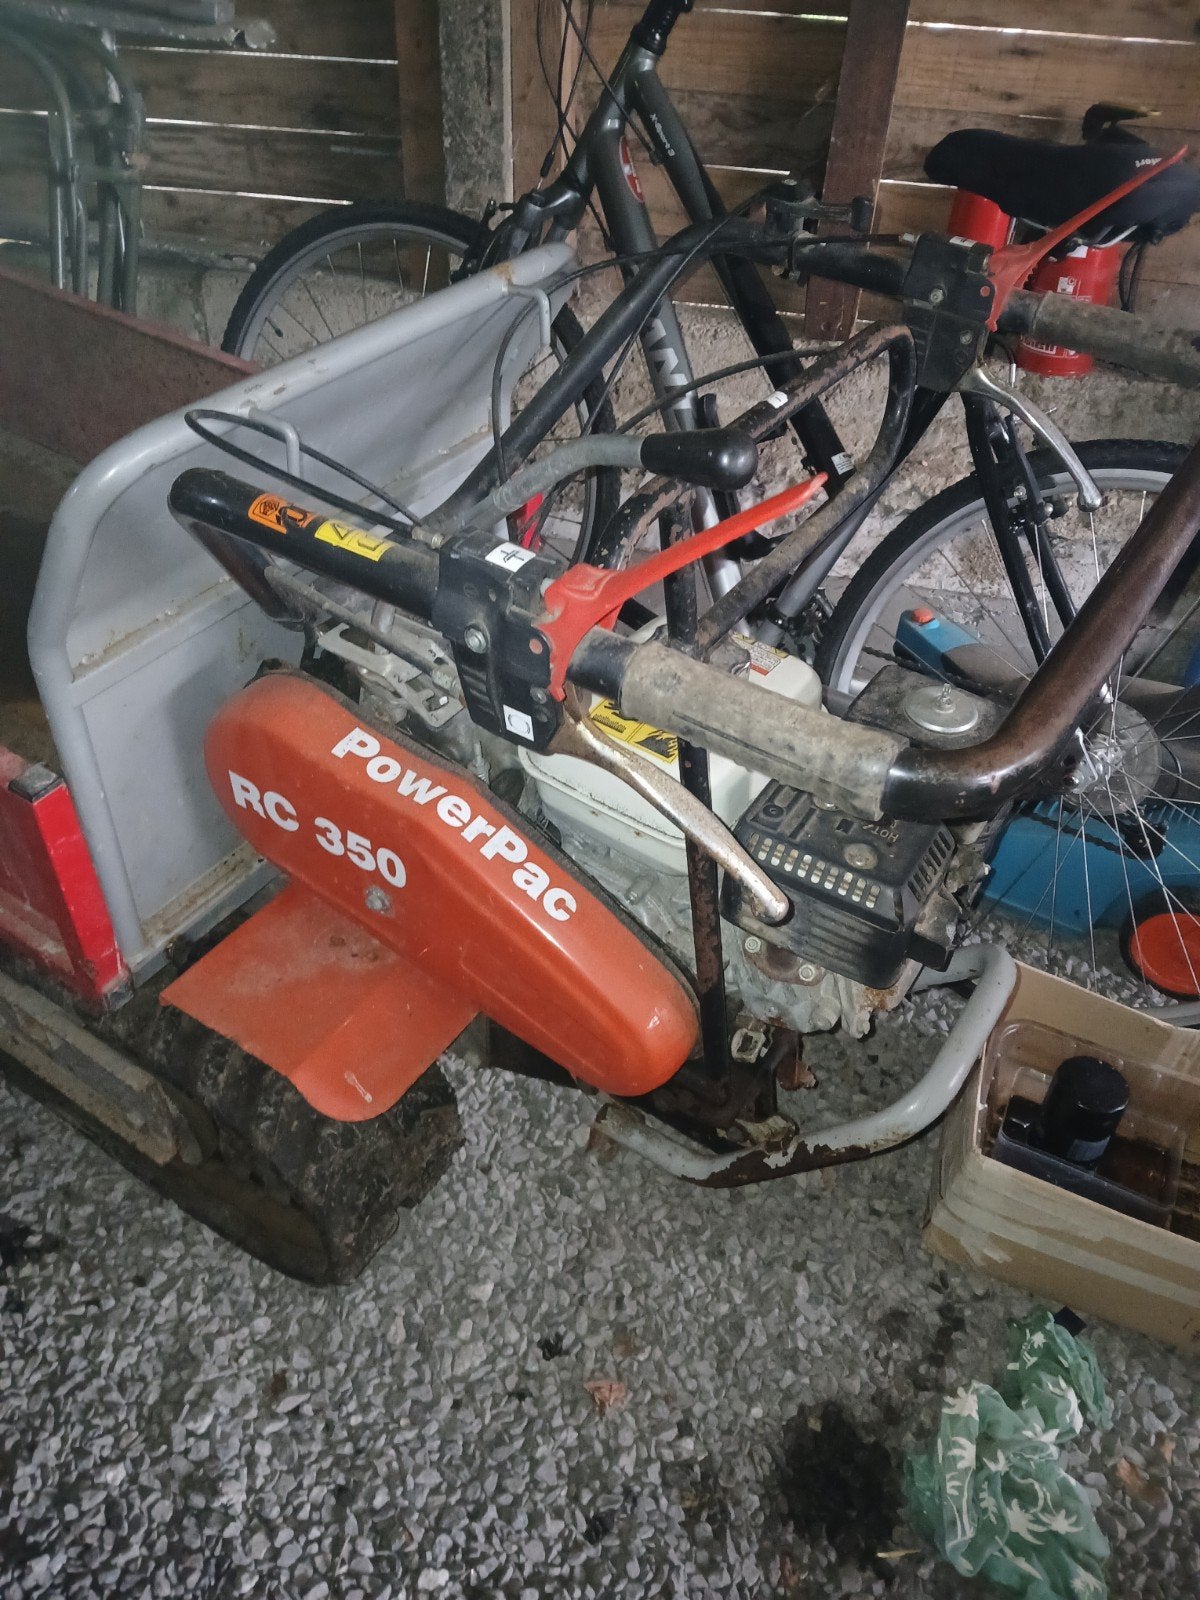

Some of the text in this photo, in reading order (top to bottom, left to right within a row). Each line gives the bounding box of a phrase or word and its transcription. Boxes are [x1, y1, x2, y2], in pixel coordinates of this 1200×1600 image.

[228, 769, 407, 889] RC 350
[331, 727, 577, 922] PowerPac
